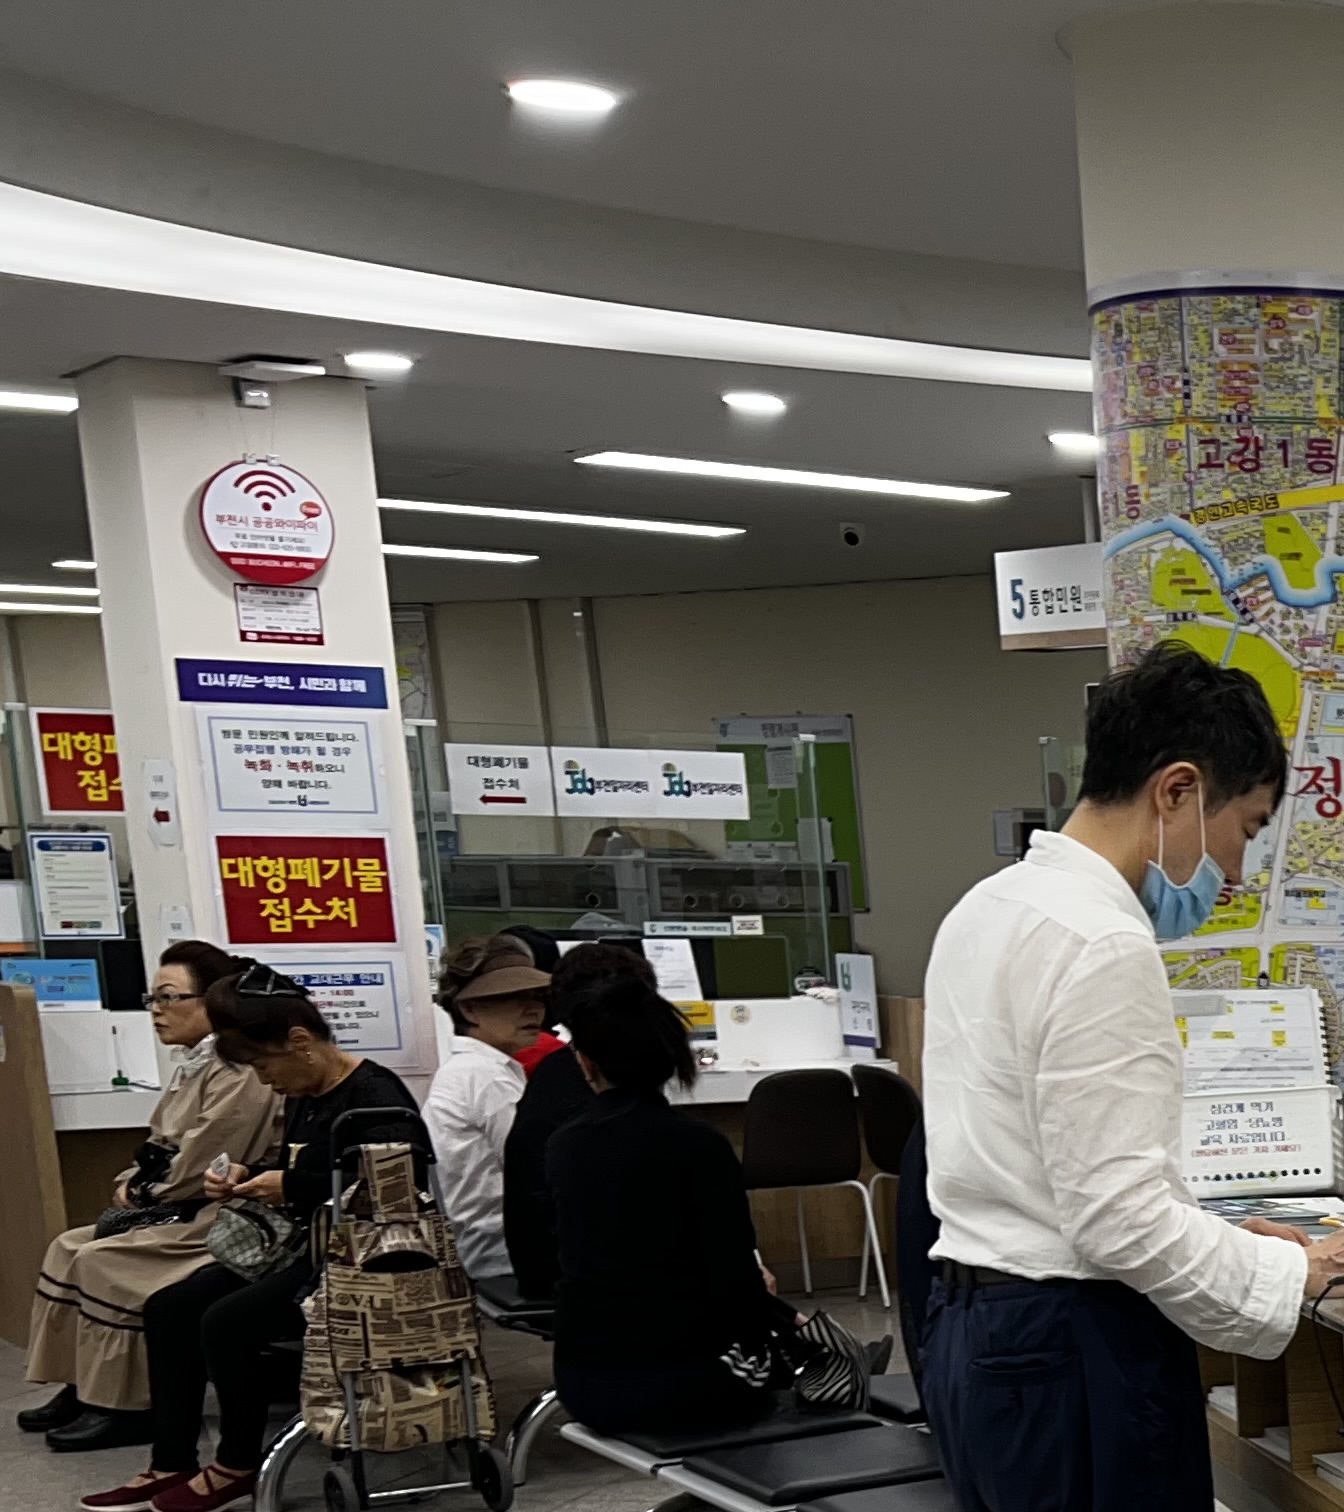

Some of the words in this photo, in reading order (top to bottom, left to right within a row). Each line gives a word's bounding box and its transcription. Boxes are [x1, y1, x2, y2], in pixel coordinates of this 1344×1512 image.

[216, 513, 249, 527] 부천시
[1010, 578, 1025, 620] 5
[1029, 585, 1082, 617] 통합민원
[198, 672, 225, 688] 다시
[467, 755, 529, 769] 대형폐기물
[482, 777, 520, 791] 접수처
[221, 856, 388, 894] 대형폐기물
[259, 897, 358, 933] 접수처
